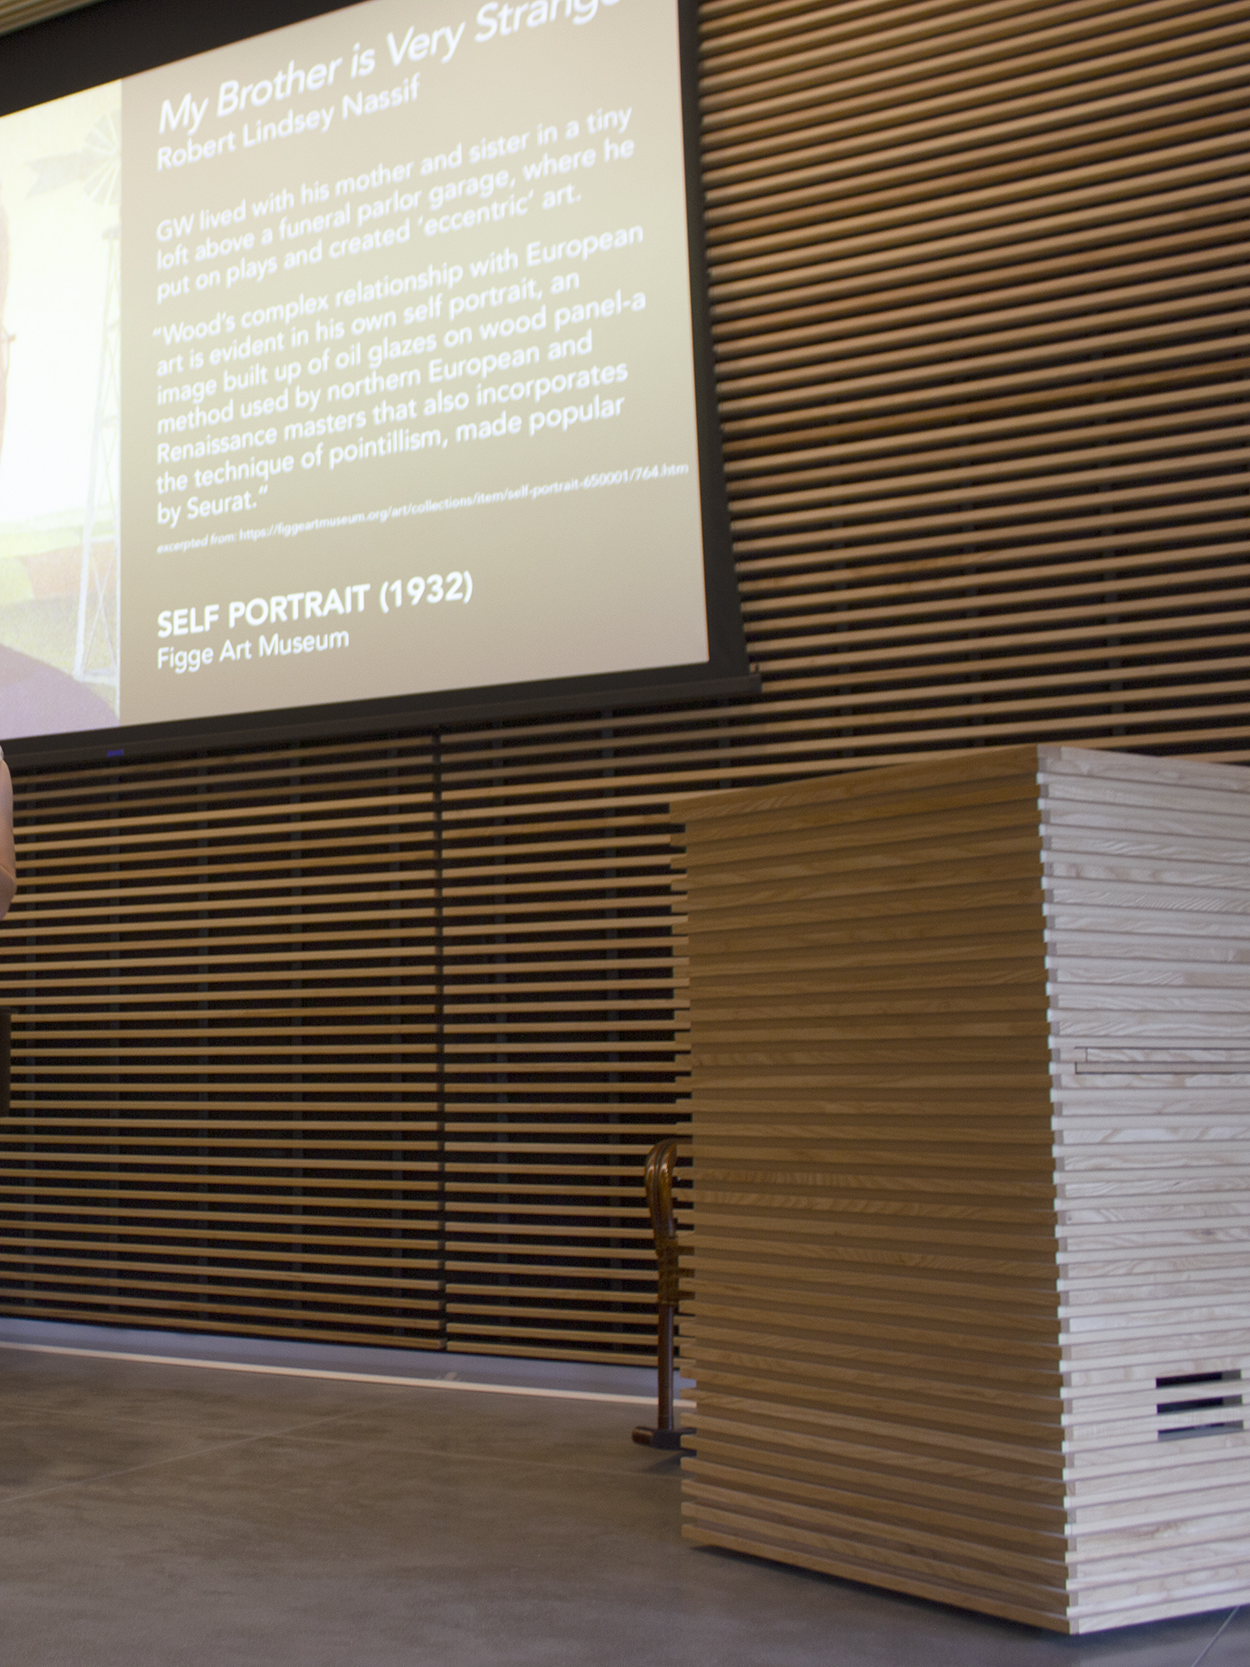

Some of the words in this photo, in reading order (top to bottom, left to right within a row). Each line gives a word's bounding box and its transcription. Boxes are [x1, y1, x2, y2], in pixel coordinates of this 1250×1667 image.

[159, 92, 210, 137] My
[216, 57, 343, 118] Brother
[350, 42, 376, 79] is
[386, 21, 466, 67] Very
[474, 0, 620, 43] Strang
[157, 131, 237, 172] Robert
[243, 106, 335, 148] Lindsey
[342, 72, 421, 120] Nassif
[156, 213, 195, 243] GW
[199, 199, 247, 232] lived
[251, 188, 295, 218] with
[300, 181, 330, 206] his
[335, 161, 414, 197] mother
[420, 142, 463, 176] and
[468, 132, 530, 164] sister
[537, 123, 558, 147] in
[565, 120, 580, 140] a
[585, 107, 633, 135] tiny
[157, 243, 189, 271] loft
[194, 233, 255, 262] above
[261, 228, 273, 246] a
[278, 202, 351, 241] funeral
[357, 189, 422, 228] parlor
[428, 170, 516, 211] garage,
[522, 148, 597, 182] where
[603, 138, 635, 163] he
[157, 275, 191, 306] put
[195, 270, 221, 291] on
[226, 256, 278, 289] plays
[283, 239, 323, 270] and
[328, 218, 411, 259] created
[541, 184, 582, 210] art.
[240, 293, 329, 329] complex
[335, 262, 464, 308] relationship
[469, 247, 519, 279] with
[526, 225, 644, 267] European
[156, 354, 184, 378] art
[189, 348, 205, 370] is
[209, 332, 285, 366] evident
[291, 326, 309, 348] in
[315, 318, 346, 343] his
[351, 311, 397, 336] own
[403, 293, 443, 325] self
[449, 277, 543, 322] portrait,
[550, 272, 580, 295] an
[157, 379, 218, 406] image
[223, 363, 269, 393] built
[274, 361, 302, 386] up
[307, 347, 331, 376] of
[334, 342, 361, 370] oil
[367, 333, 438, 370] glazes
[443, 326, 473, 349] on
[478, 304, 547, 341] wood
[554, 289, 647, 333] panel-a
[157, 398, 234, 436] method
[240, 387, 289, 420] used
[295, 385, 322, 413] by
[327, 368, 422, 402] northern
[428, 346, 540, 384] European
[547, 328, 593, 361] and
[157, 427, 278, 465] Renaissance
[284, 410, 367, 442] masters
[371, 398, 418, 426] that
[423, 389, 470, 417] also
[476, 363, 629, 407] incorporates
[155, 470, 189, 495] the
[193, 455, 295, 489] technique
[300, 442, 324, 470] of
[329, 428, 449, 471] pointillism,
[455, 410, 523, 443] made
[528, 394, 626, 438] popular
[156, 534, 209, 555] excerpted
[209, 533, 238, 546] from:
[157, 501, 182, 530] by
[157, 603, 221, 639] SELF
[228, 583, 372, 629] PORTRAIT
[379, 570, 474, 615] (1932)
[157, 646, 215, 675] Figge
[218, 639, 253, 663] Art
[258, 630, 350, 658] Museum
